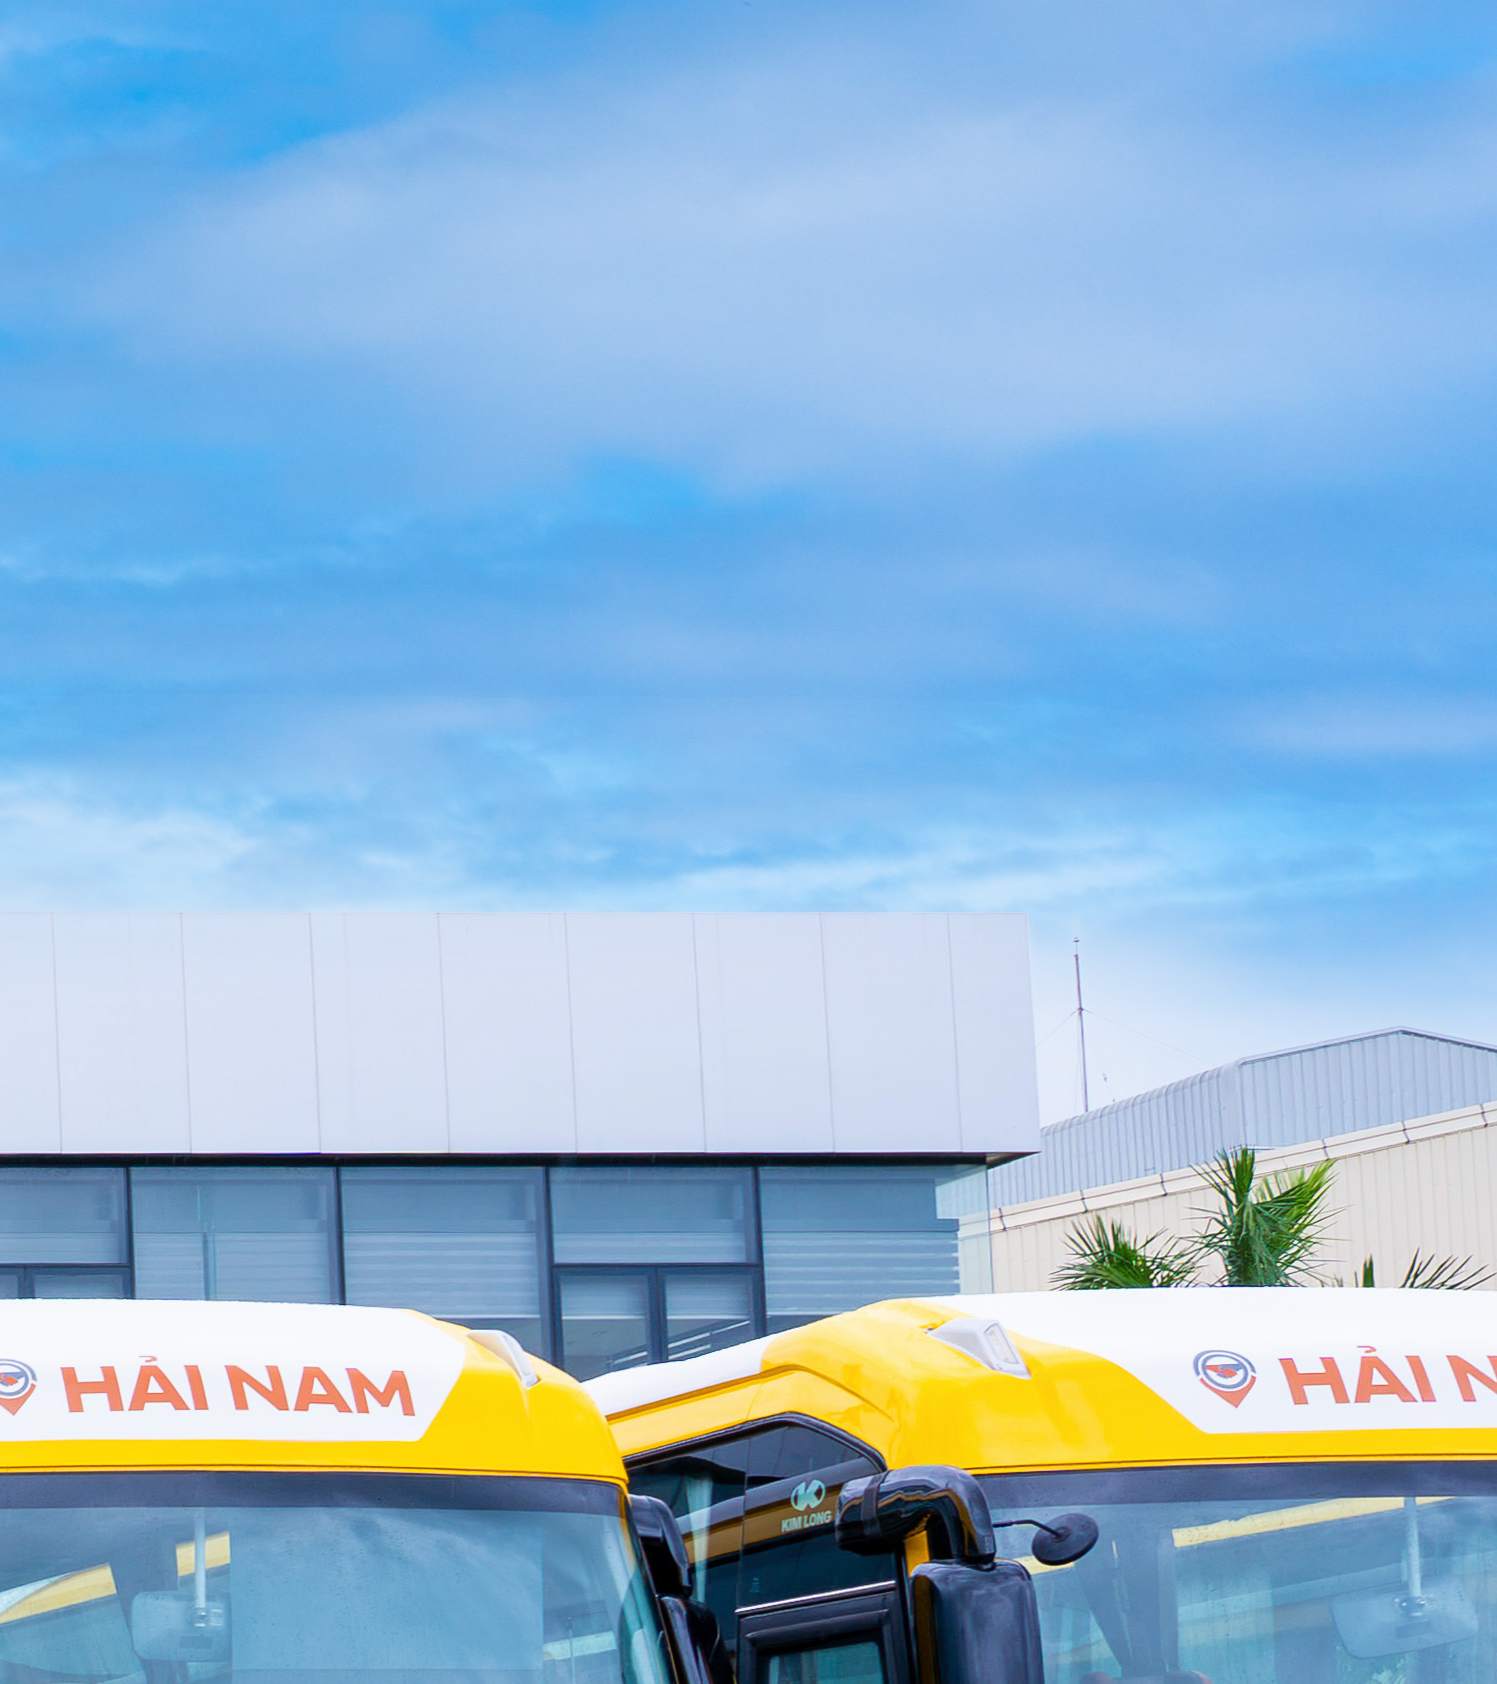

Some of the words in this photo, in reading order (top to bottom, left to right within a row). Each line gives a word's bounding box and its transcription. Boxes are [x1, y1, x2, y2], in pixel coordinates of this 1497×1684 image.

[60, 1355, 209, 1413] HẢI
[224, 1365, 416, 1416] NAM
[1278, 1345, 1437, 1405] HẢI
[782, 1516, 802, 1532] KIM
[804, 1510, 831, 1528] LONG
